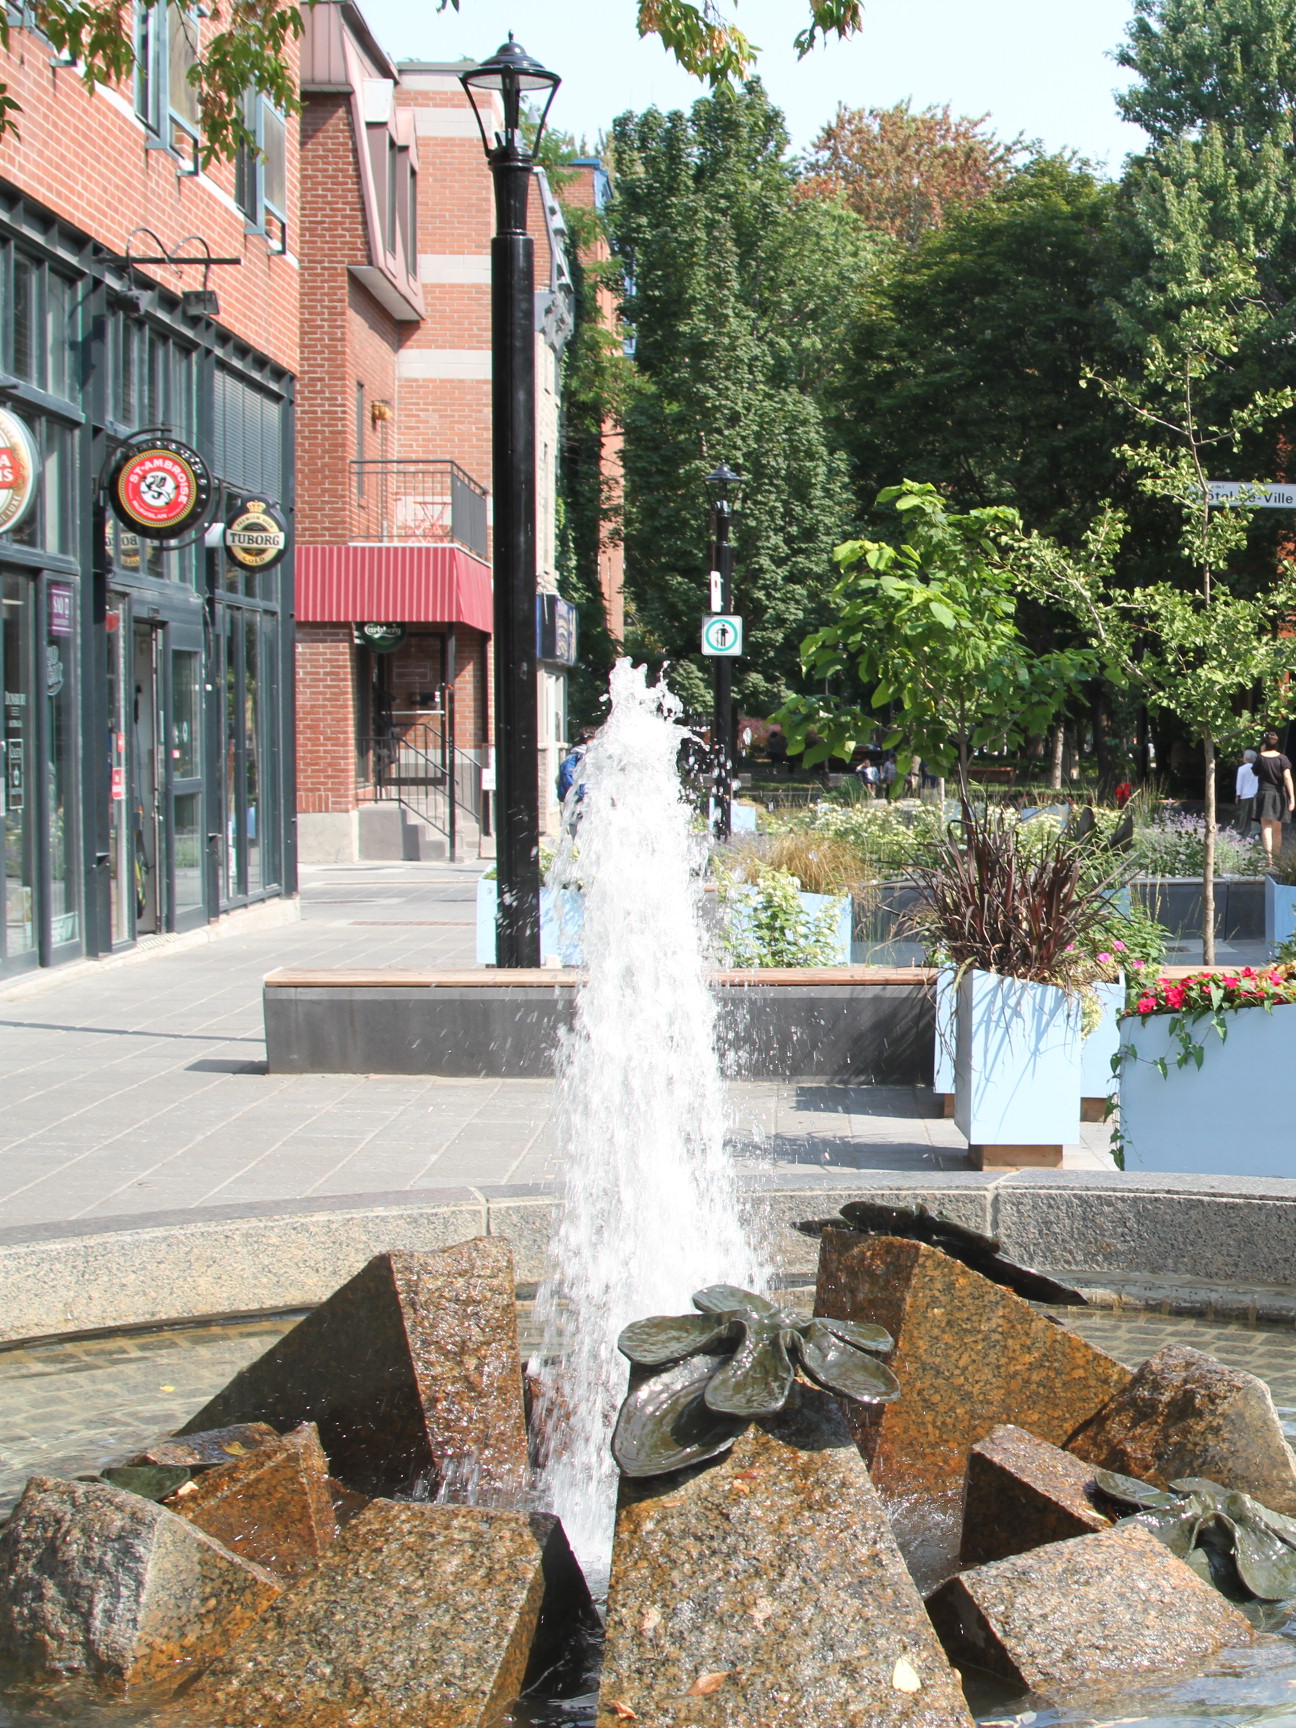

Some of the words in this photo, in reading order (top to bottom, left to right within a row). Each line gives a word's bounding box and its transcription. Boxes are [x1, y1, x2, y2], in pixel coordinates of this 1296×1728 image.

[129, 458, 189, 505] ST-AMBROISE
[230, 532, 280, 546] TUBORG
[242, 556, 265, 564] GOLD
[364, 623, 402, 637] Carlsberg
